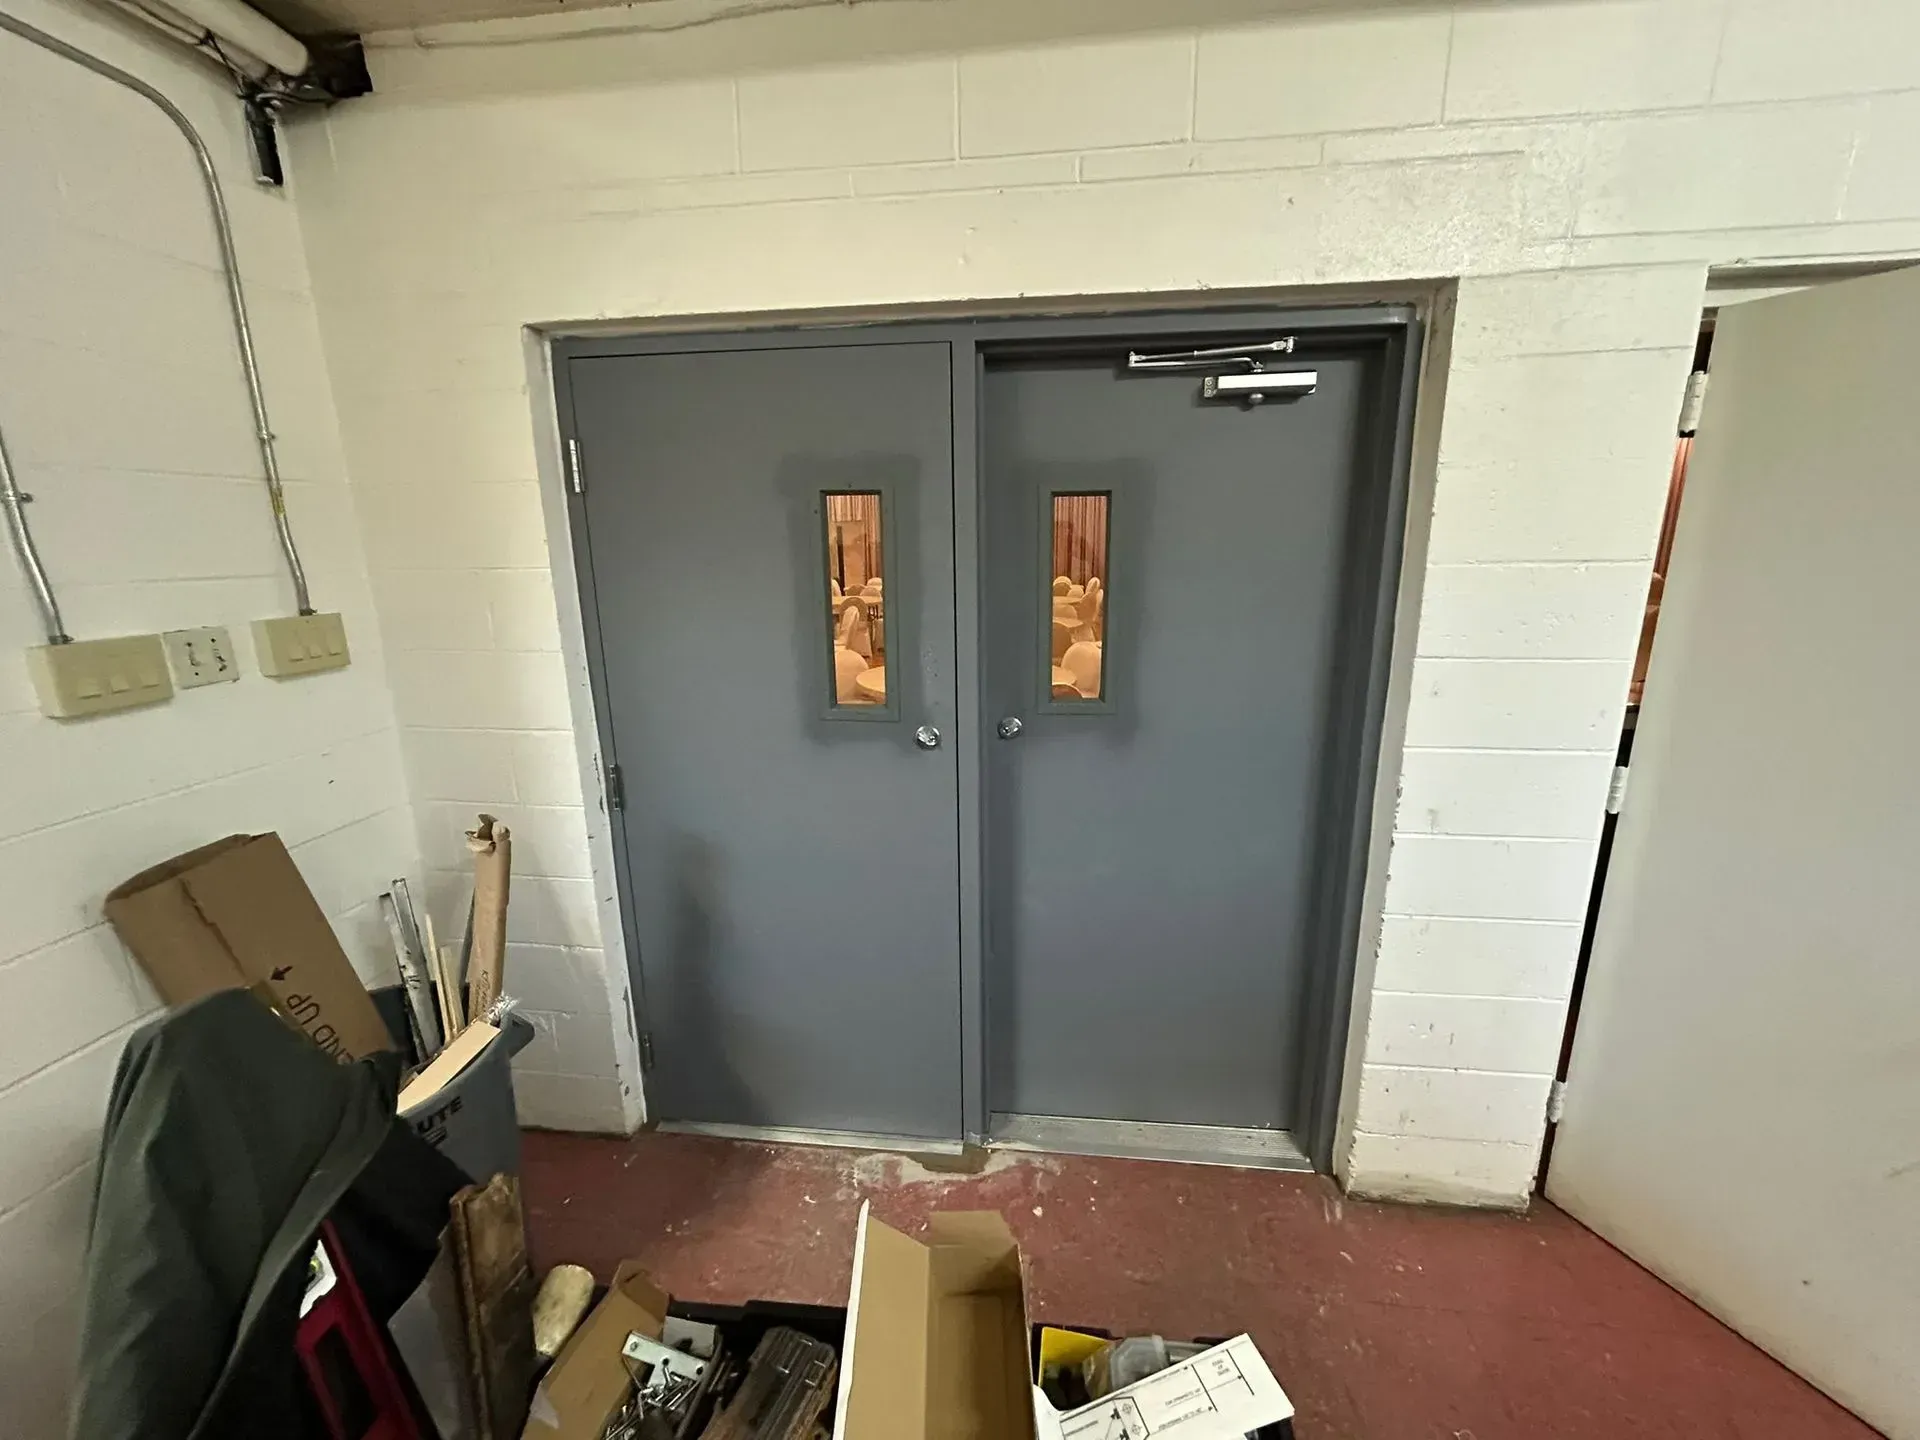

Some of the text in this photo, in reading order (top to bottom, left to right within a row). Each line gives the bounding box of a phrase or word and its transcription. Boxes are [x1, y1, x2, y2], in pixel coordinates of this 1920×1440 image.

[286, 994, 355, 1062] ND UP
[416, 1095, 463, 1133] UTE
